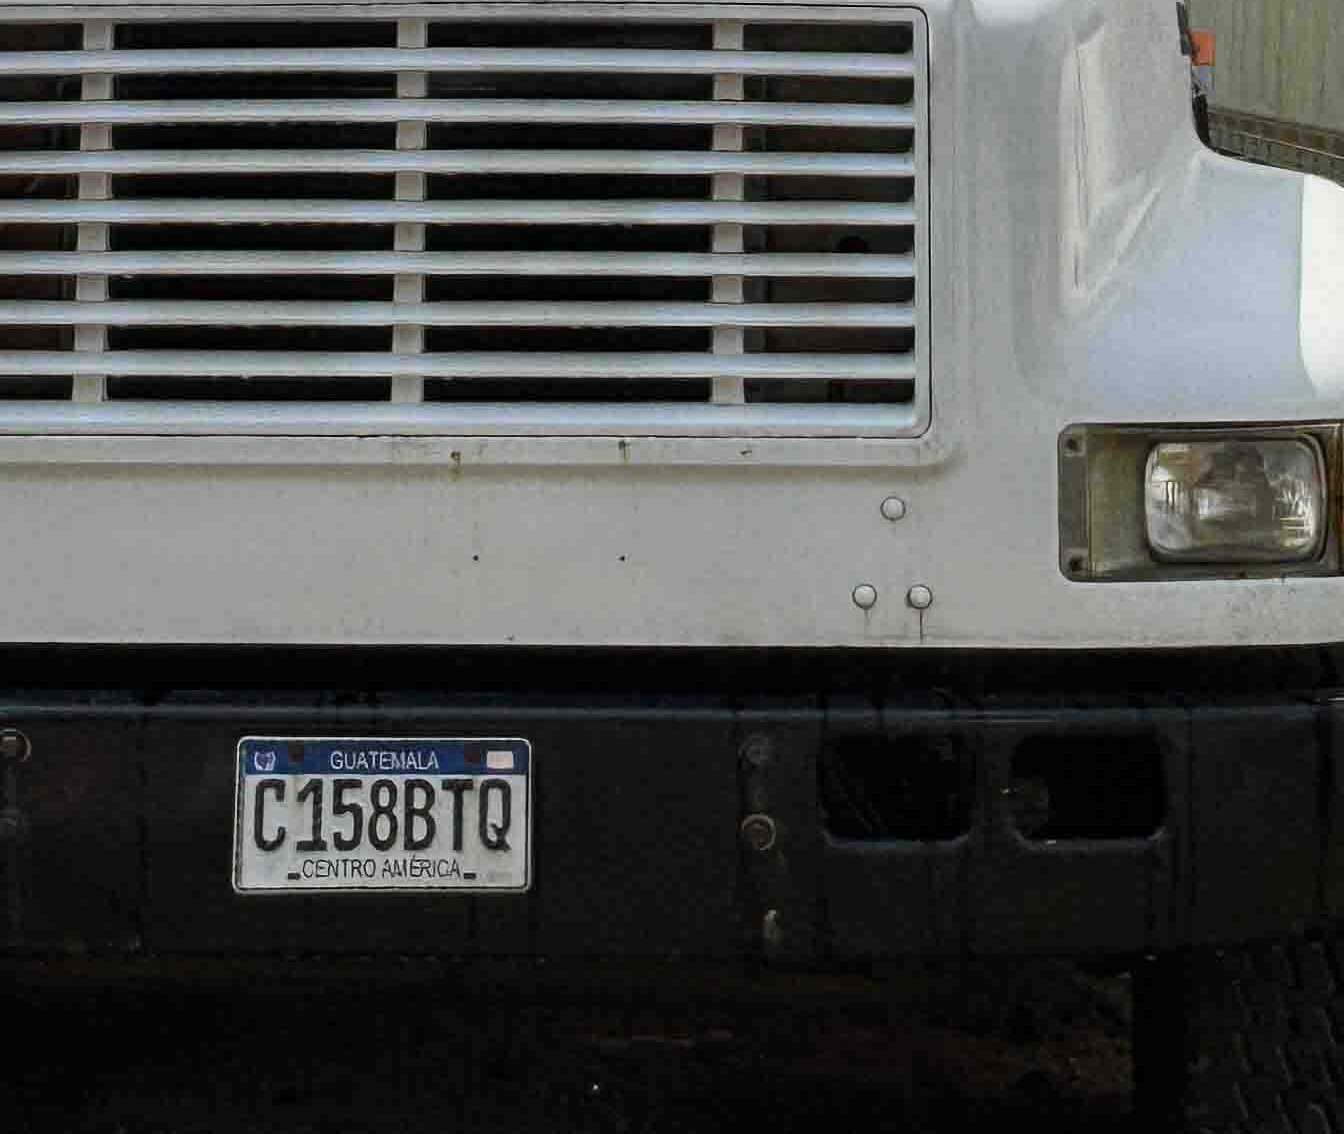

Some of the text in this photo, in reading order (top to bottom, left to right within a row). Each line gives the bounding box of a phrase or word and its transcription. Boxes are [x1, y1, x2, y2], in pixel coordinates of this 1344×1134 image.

[330, 750, 440, 770] GUATEMALA
[254, 778, 512, 852] C158BTQ
[302, 853, 462, 879] CENTRO AMÉRICA
